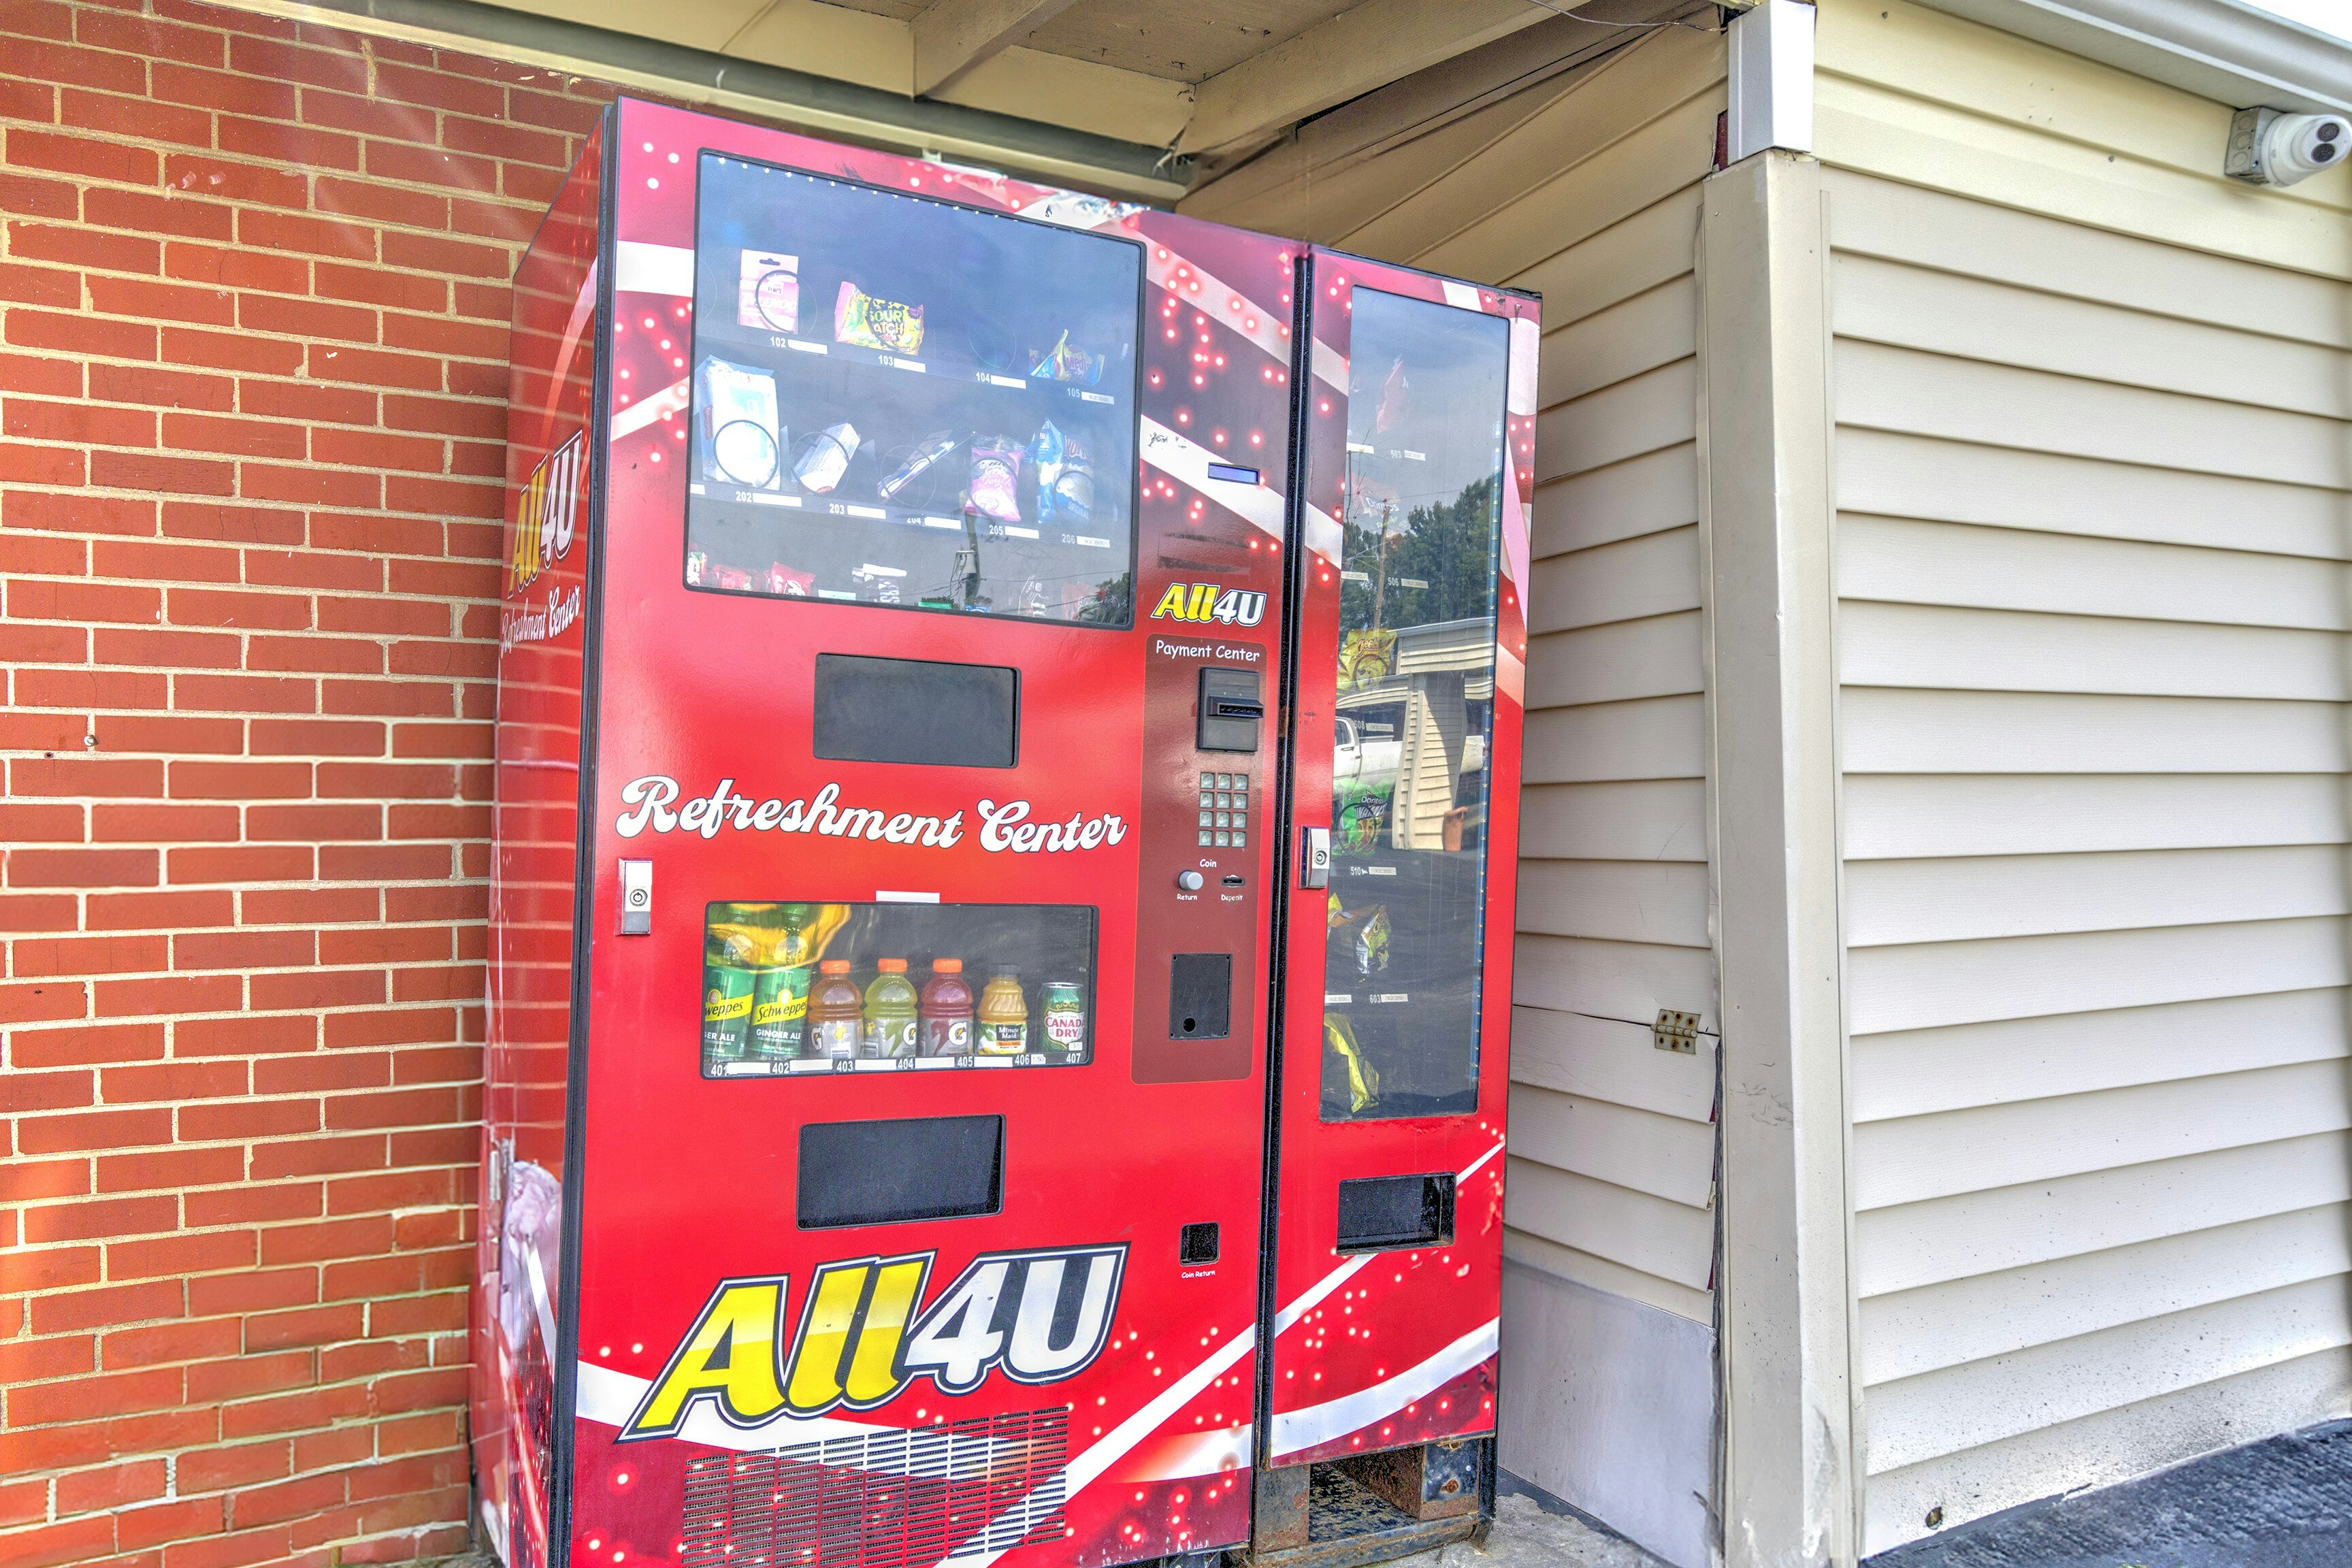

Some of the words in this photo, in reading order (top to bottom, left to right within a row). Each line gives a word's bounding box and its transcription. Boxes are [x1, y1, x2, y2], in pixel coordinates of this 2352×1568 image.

[870, 309, 904, 323] SOUR
[872, 321, 904, 336] ATCH
[770, 336, 786, 348] 102
[878, 355, 894, 366] 103
[976, 372, 991, 383] 104
[1067, 387, 1081, 398] 105
[1390, 449, 1402, 459] 503
[735, 491, 753, 502] 202
[508, 429, 583, 600] All4U
[829, 503, 845, 515] 203
[1067, 501, 1090, 520] ORIGINAL
[989, 525, 1004, 536] 205
[1062, 534, 1075, 544] 206
[1388, 577, 1399, 587] 506
[1150, 582, 1268, 627] All4U
[500, 605, 547, 660] Refreshment
[548, 583, 582, 639] Center
[1156, 640, 1213, 659] Payment
[1215, 645, 1260, 663] Center
[1354, 720, 1365, 730] 508
[1360, 795, 1384, 804] Doritos
[615, 773, 965, 849] Refreshment
[975, 797, 1128, 853] Center
[1199, 858, 1217, 868] Coin
[1350, 866, 1361, 876] 510
[1177, 893, 1198, 902] Return
[1221, 894, 1243, 902] Deposit
[1369, 994, 1381, 1004] 603
[705, 1001, 744, 1017] weppes
[757, 999, 807, 1022] Schweppes
[704, 1031, 717, 1041] GER
[719, 1032, 736, 1042] ALE
[756, 1028, 789, 1040] GINGER
[789, 1032, 802, 1041] ALE
[902, 1022, 917, 1046] G
[948, 1022, 967, 1046] G
[1056, 1028, 1079, 1038] DRY
[898, 1058, 914, 1070] 404
[957, 1056, 973, 1068] 405
[1015, 1054, 1030, 1066] 406
[1066, 1053, 1081, 1064] 407
[772, 1062, 789, 1074] 402
[836, 1060, 854, 1072] 403
[614, 1241, 1131, 1444] All4U
